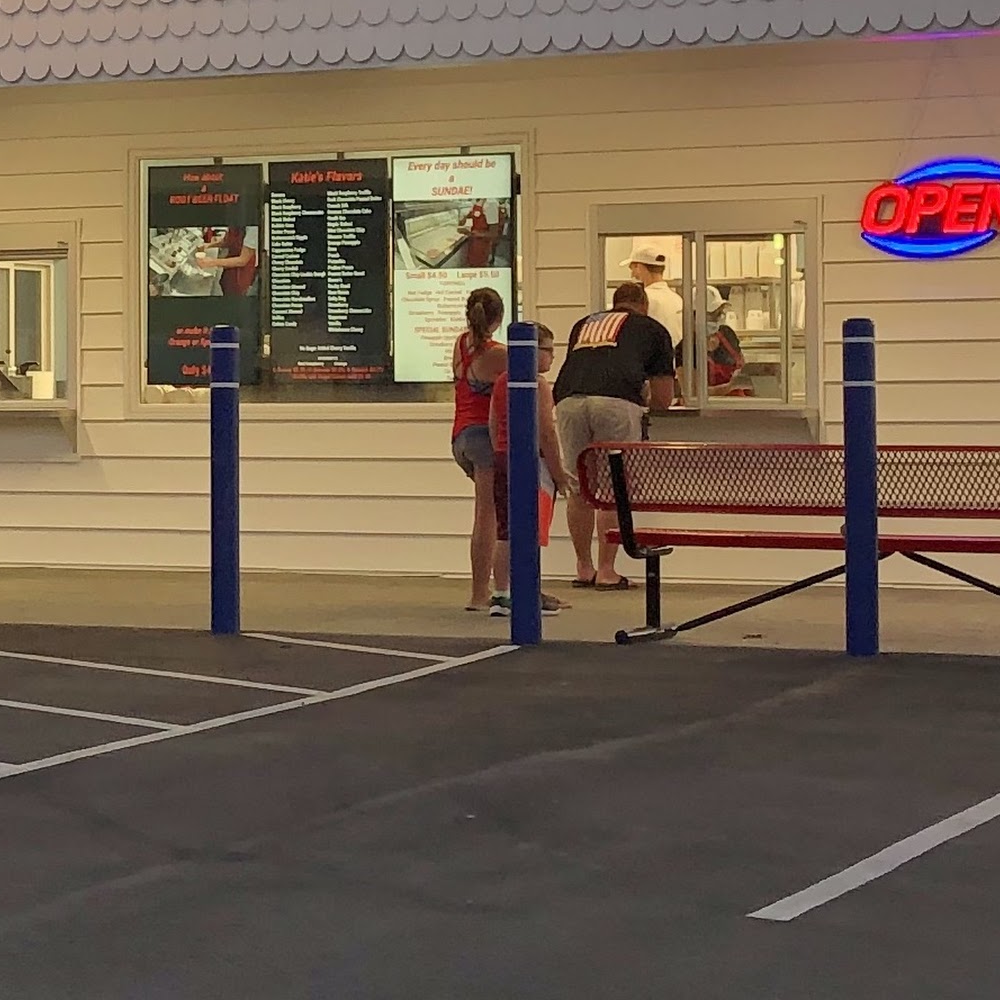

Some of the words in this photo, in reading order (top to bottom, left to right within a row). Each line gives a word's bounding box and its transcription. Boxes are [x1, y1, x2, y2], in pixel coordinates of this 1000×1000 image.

[408, 162, 432, 172] Every
[434, 160, 450, 171] day
[452, 159, 483, 169] should
[485, 159, 496, 169] be
[431, 186, 473, 196] SUNDAE!
